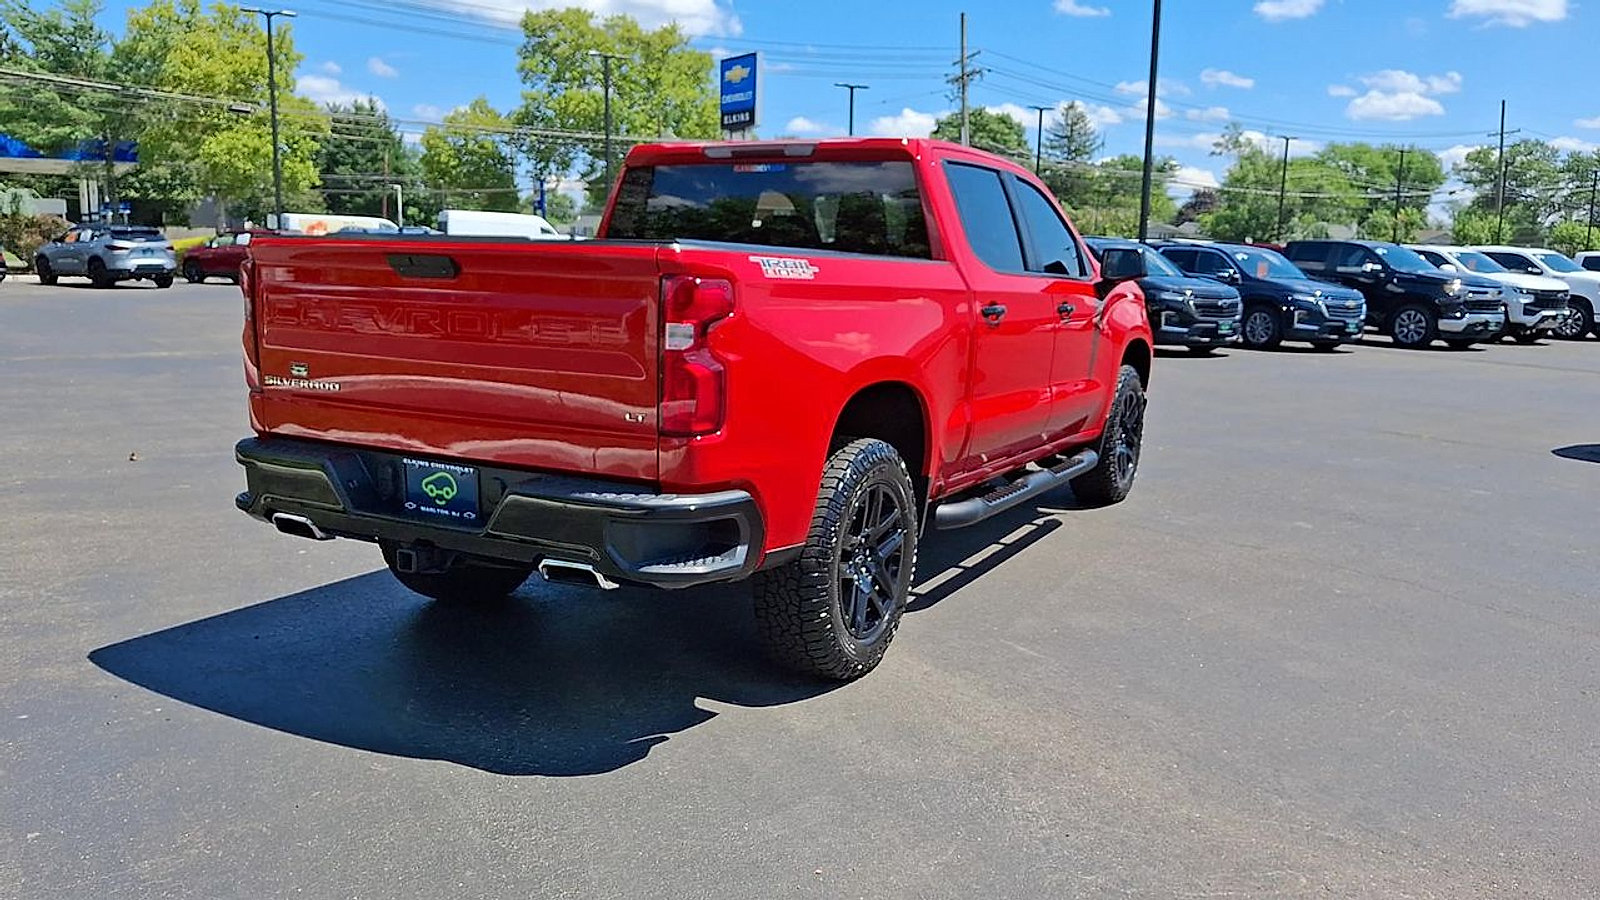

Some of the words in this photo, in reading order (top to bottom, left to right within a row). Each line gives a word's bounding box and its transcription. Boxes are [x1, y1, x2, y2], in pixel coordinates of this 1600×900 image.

[267, 299, 629, 345] CHEVROLET
[263, 375, 341, 391] SILVERADO
[624, 411, 647, 423] LT
[403, 458, 429, 467] ELKINS
[430, 462, 474, 473] CHEVROLET
